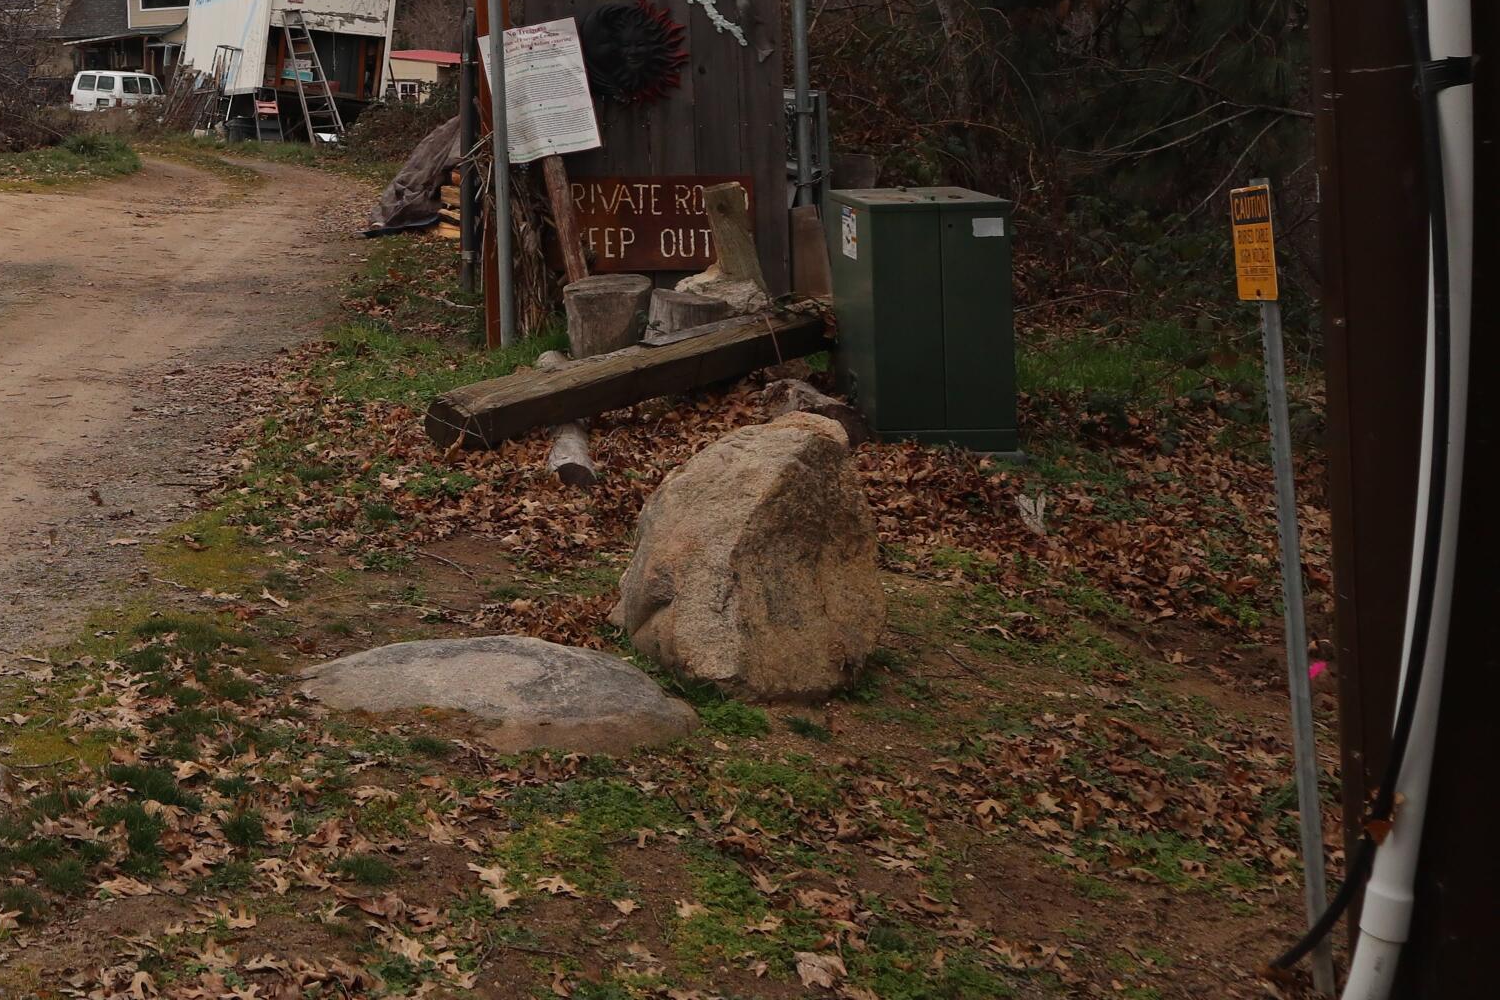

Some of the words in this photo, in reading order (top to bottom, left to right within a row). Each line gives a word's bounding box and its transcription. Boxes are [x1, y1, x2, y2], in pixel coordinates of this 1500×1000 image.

[570, 183, 663, 215] RIVATE
[1234, 194, 1269, 220] CAUTION
[580, 227, 636, 259] EEP
[660, 228, 712, 259] OUT
